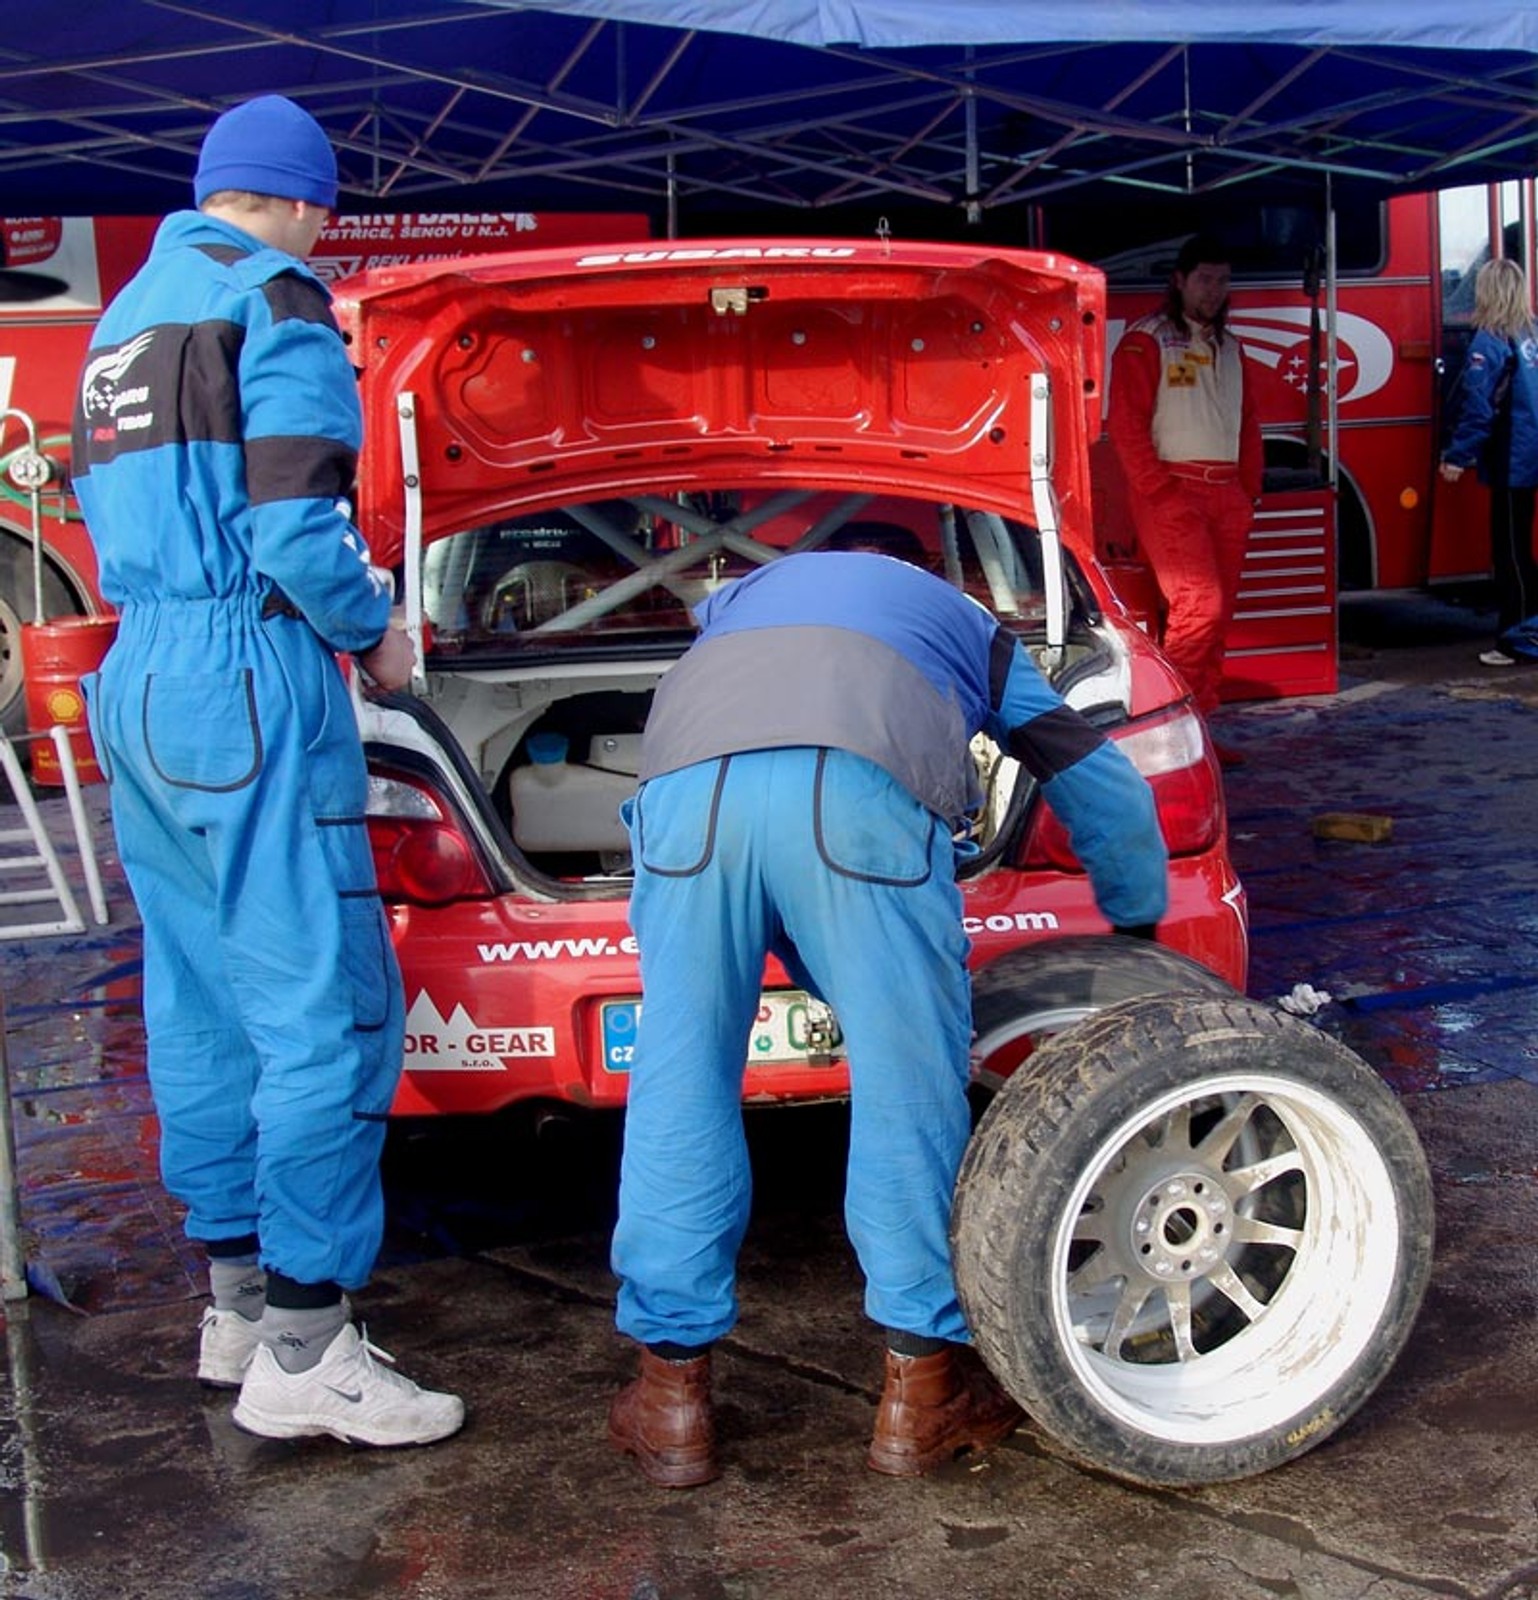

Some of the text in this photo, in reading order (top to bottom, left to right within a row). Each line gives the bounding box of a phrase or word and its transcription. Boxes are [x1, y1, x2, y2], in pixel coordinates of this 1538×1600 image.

[461, 226, 475, 236] U
[575, 247, 856, 266] SUBARU
[963, 911, 1059, 934] com
[465, 1033, 548, 1053] GEAR
